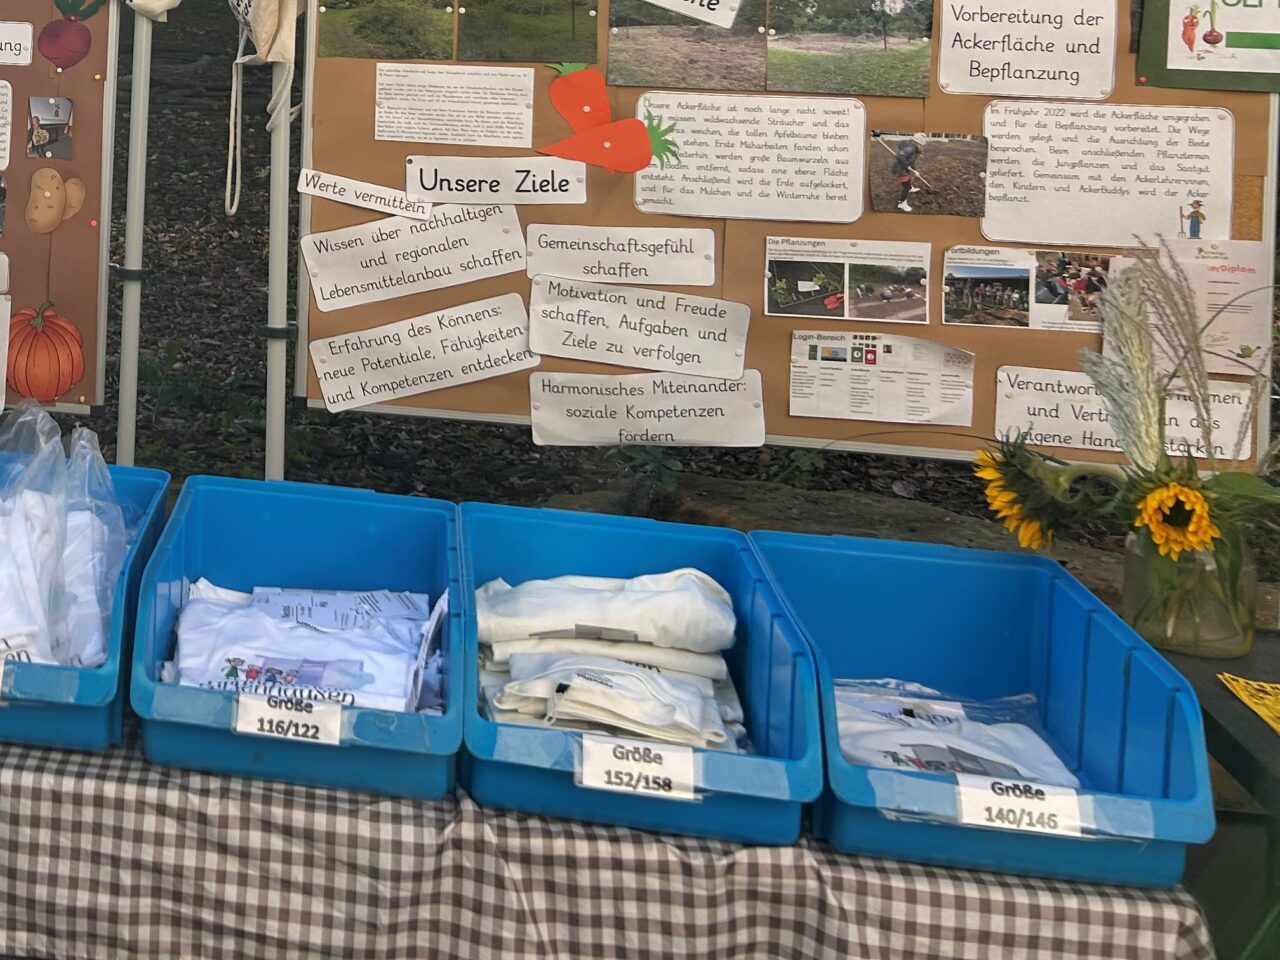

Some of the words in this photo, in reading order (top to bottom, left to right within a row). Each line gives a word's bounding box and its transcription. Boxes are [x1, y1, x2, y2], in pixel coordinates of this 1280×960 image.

[951, 4, 1063, 30] Vorbereitung
[1073, 8, 1104, 26] der
[951, 32, 1055, 53] Ackerfläche
[1066, 37, 1101, 54] und
[969, 60, 1079, 86] Bepflanzung
[420, 168, 500, 193] Unsere
[515, 170, 569, 193] Ziele
[305, 173, 346, 196] Werte
[354, 190, 425, 214] vermitteln
[313, 238, 364, 254] Wissen
[371, 227, 401, 243] über
[410, 204, 503, 234] nachhaltigen
[360, 251, 388, 269] und
[395, 236, 469, 263] regionalen
[538, 233, 694, 257] Gemeinschaftsgefühl
[781, 238, 826, 248] Pflanzungen
[320, 264, 452, 301] Lebensmittelanbau
[460, 249, 522, 271] schaffen
[582, 260, 648, 278] schaffen
[548, 280, 627, 304] Motivation
[636, 295, 666, 310] und
[675, 297, 727, 318] Freude
[328, 333, 401, 355] Erfahrung
[407, 322, 432, 338] des
[437, 306, 502, 330] Könnens:
[541, 305, 609, 329] schaffen,
[619, 314, 689, 337] Aufgaben
[698, 327, 727, 342] und
[323, 366, 355, 381] neue
[360, 346, 435, 372] Potentiale,
[440, 326, 524, 355] Fähigkeiten
[561, 330, 597, 350] Ziele
[606, 343, 624, 354] zu
[633, 344, 702, 366] verfolgen
[327, 385, 355, 405] und
[360, 370, 454, 397] Kompetenzen
[461, 348, 533, 375] entdecken
[542, 378, 644, 396] Harmonisches
[653, 379, 747, 394] Miteinander:
[566, 404, 617, 419] soziale
[626, 404, 725, 422] Kompetenzen
[1027, 403, 1060, 419] und
[1190, 414, 1221, 430] ds
[618, 428, 676, 444] fördern
[258, 718, 319, 740] 116/122
[612, 744, 663, 765] Größe
[605, 770, 673, 792] 152/158
[991, 781, 1045, 801] Größe
[984, 806, 1058, 829] 140/146
